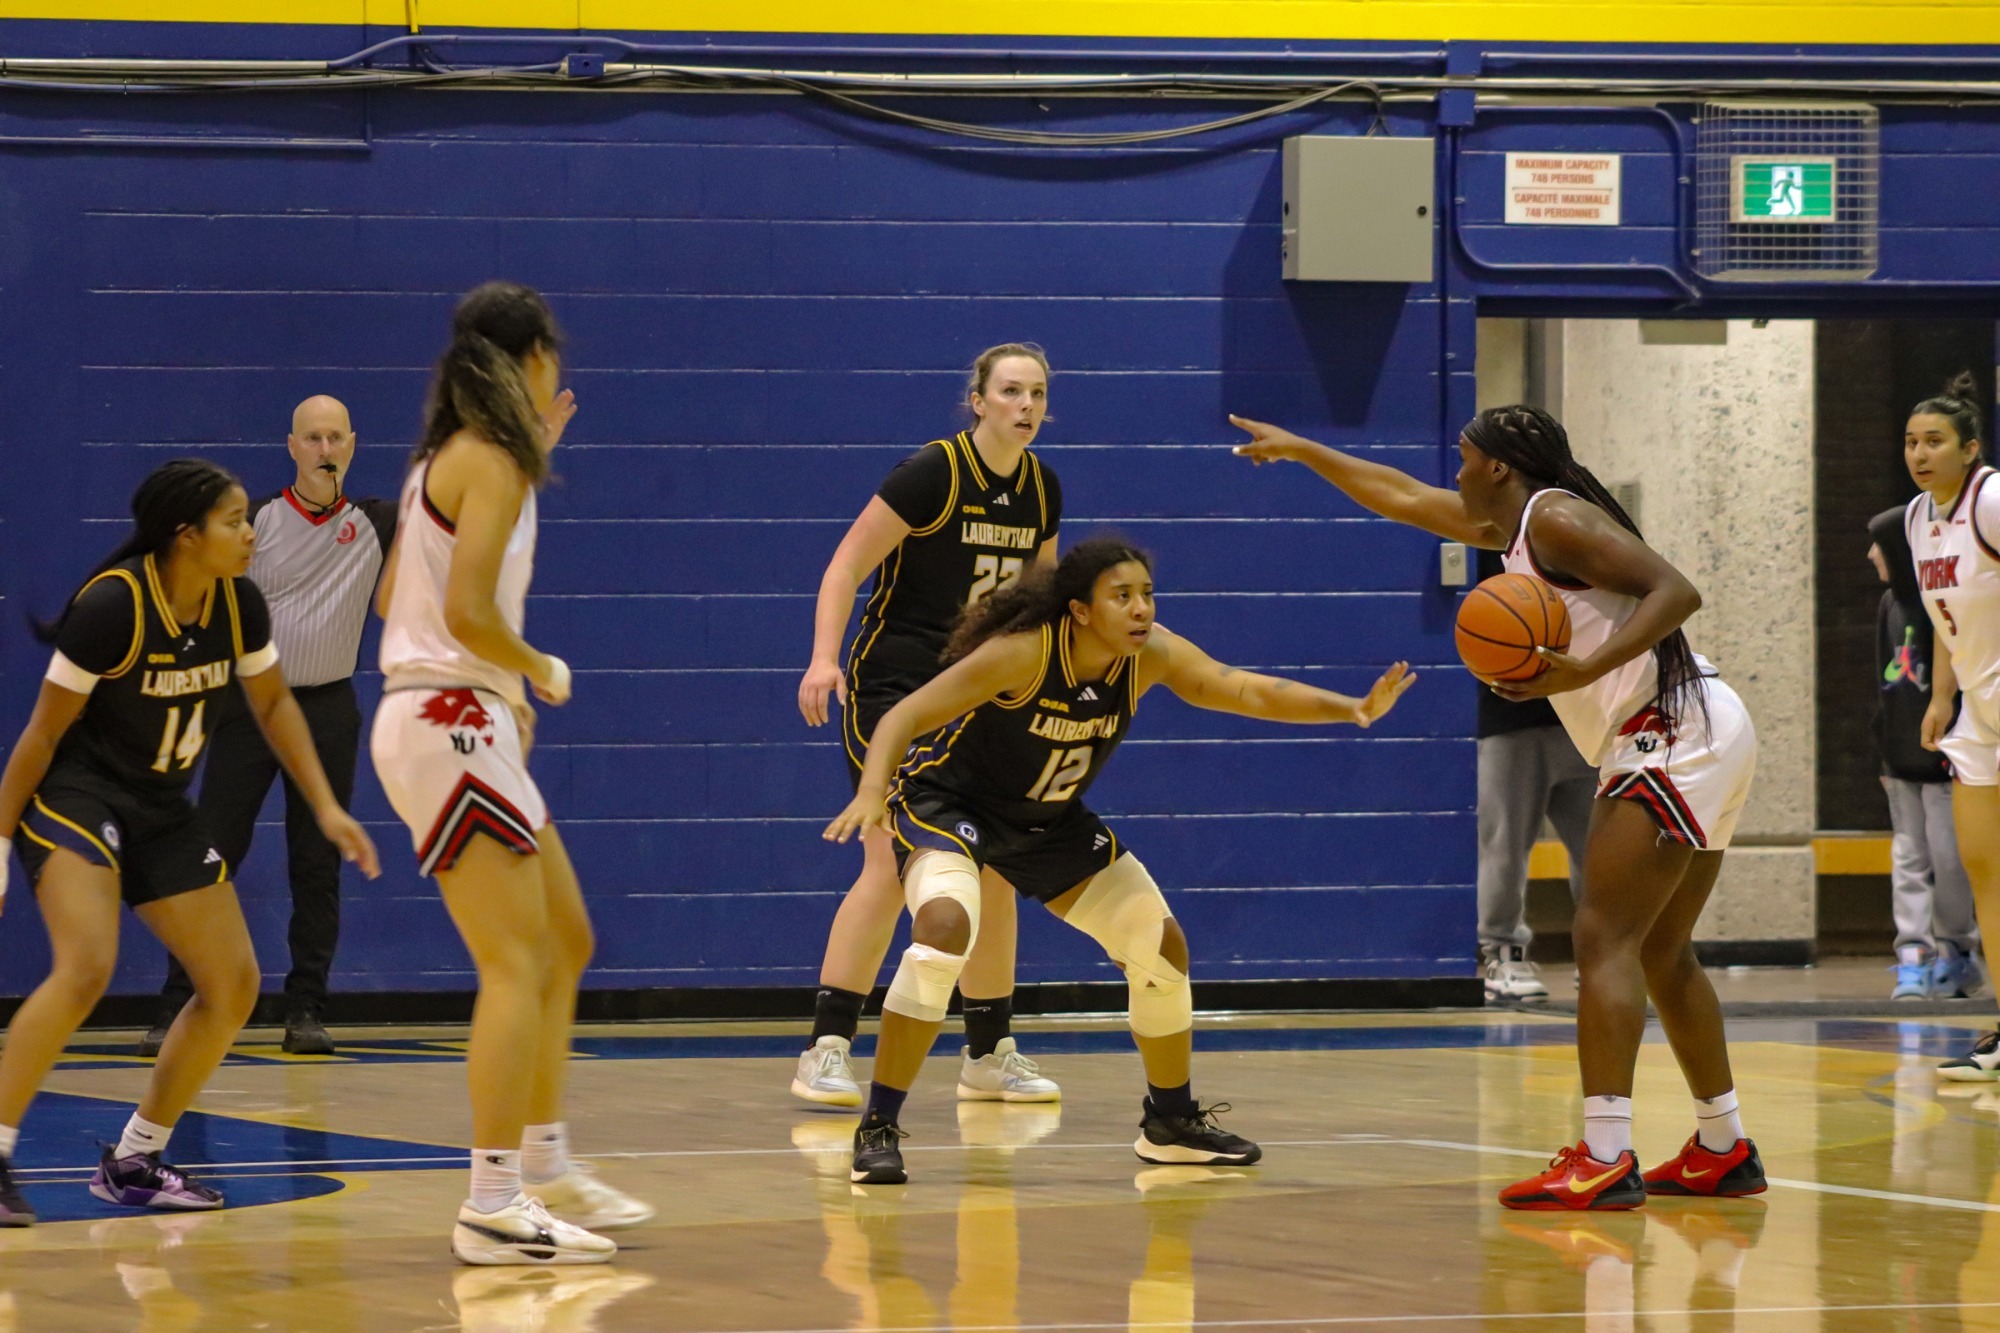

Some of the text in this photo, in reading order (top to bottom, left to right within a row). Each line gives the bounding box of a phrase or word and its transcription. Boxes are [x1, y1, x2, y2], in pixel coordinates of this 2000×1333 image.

[1515, 159, 1610, 170] MAXIMUM CAPACITY
[1531, 173, 1594, 184] 748 PERSONS
[1561, 194, 1610, 205] MAXIMALE
[1525, 207, 1600, 219] 748 PERSONNES
[1918, 555, 1960, 591] YORK
[1935, 598, 1957, 636] 5
[150, 699, 206, 773] 14
[1025, 745, 1094, 802] 12
